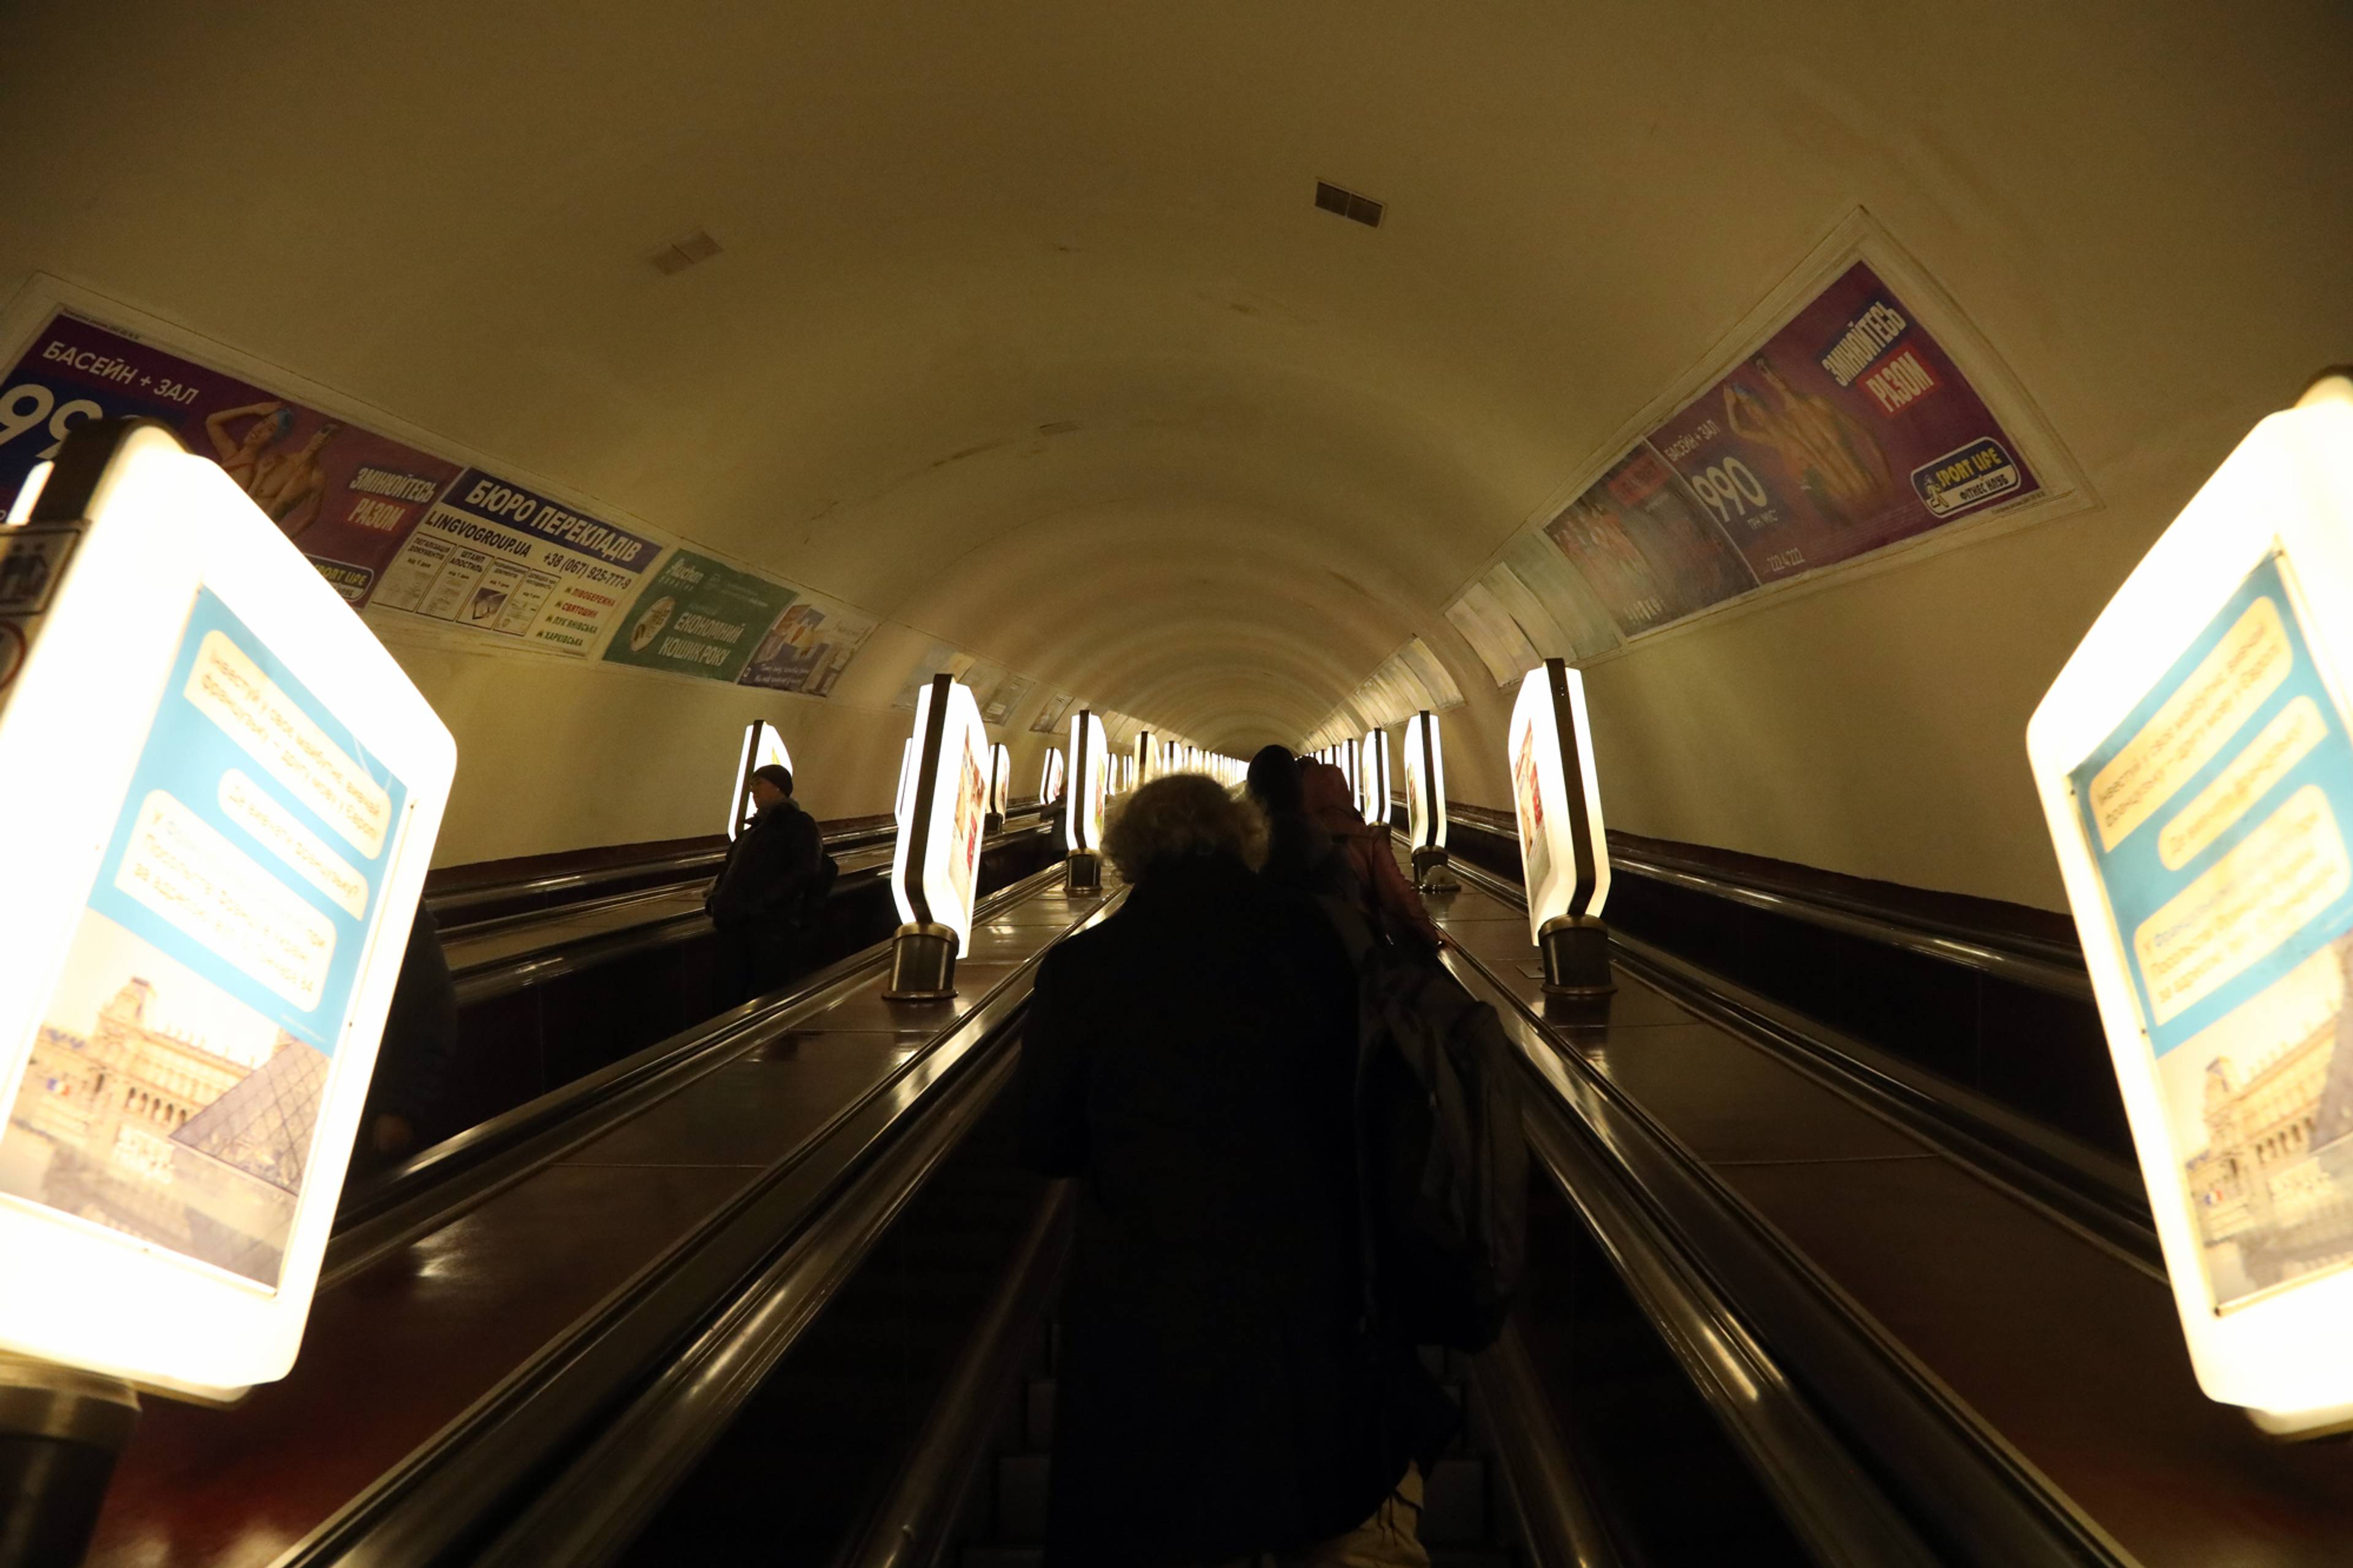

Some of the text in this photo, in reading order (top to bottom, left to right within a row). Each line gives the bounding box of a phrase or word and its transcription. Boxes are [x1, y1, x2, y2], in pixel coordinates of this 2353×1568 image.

[1821, 300, 1907, 387] ЗМІНЮЙТЕСЬ
[42, 340, 199, 405] БАСЕЙН + ЗАЛ
[1865, 351, 1935, 412] РАЗОМ
[0, 383, 144, 460] 99
[1663, 434, 1700, 462] БАСЕЙН
[1697, 419, 1721, 440] ЗАЛ
[1935, 447, 2002, 488] SPORT LIFE
[349, 468, 437, 503] ЗМІНЮЙТЕСЬ
[1692, 456, 1768, 523] 990
[1960, 474, 2010, 501] ФІТНЕС КЛУБ
[347, 498, 406, 531] РАЗОМ
[465, 480, 642, 562] БЮРО ПЕРЕКЛАДІВ
[424, 510, 532, 558] LINGVOGROUP.UA
[315, 564, 346, 581] PORT
[449, 557, 483, 573] АПОСТИЛЬ
[460, 550, 485, 562] ШТАМП
[544, 552, 564, 567] +38
[559, 558, 590, 580] (067)
[587, 566, 633, 590] 925-777-9
[666, 558, 704, 584] Auchan
[561, 602, 599, 619] СВЯТОШИН
[571, 588, 617, 608] ЛІВОБЕРЕЖНА
[543, 631, 584, 647] ХАРКІВСЬКА
[673, 611, 747, 644] ЕКОНОМНИЙ
[658, 636, 731, 667] КОШИК РОКУ
